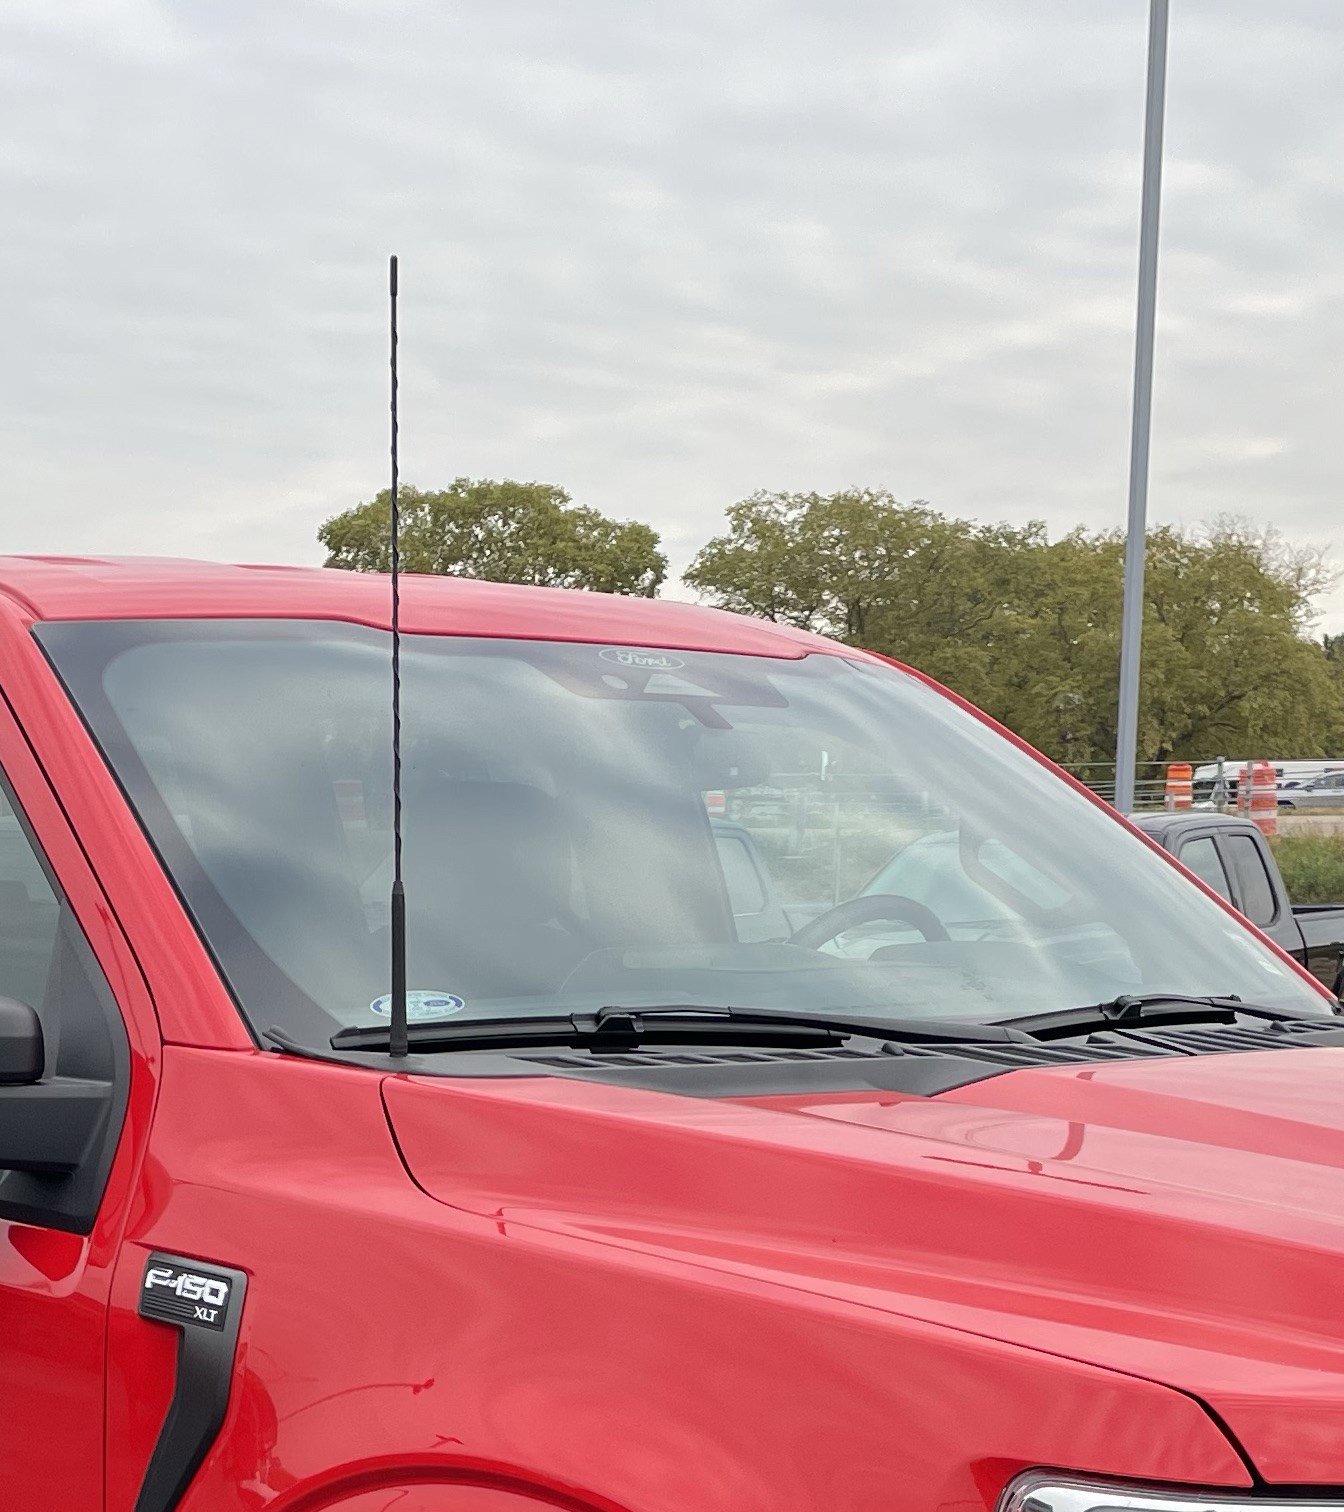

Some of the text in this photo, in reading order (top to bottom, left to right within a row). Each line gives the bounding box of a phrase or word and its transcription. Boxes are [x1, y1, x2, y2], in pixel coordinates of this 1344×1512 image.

[615, 650, 672, 667] Ford
[144, 1267, 229, 1306] F-150
[193, 1305, 219, 1322] XLT
